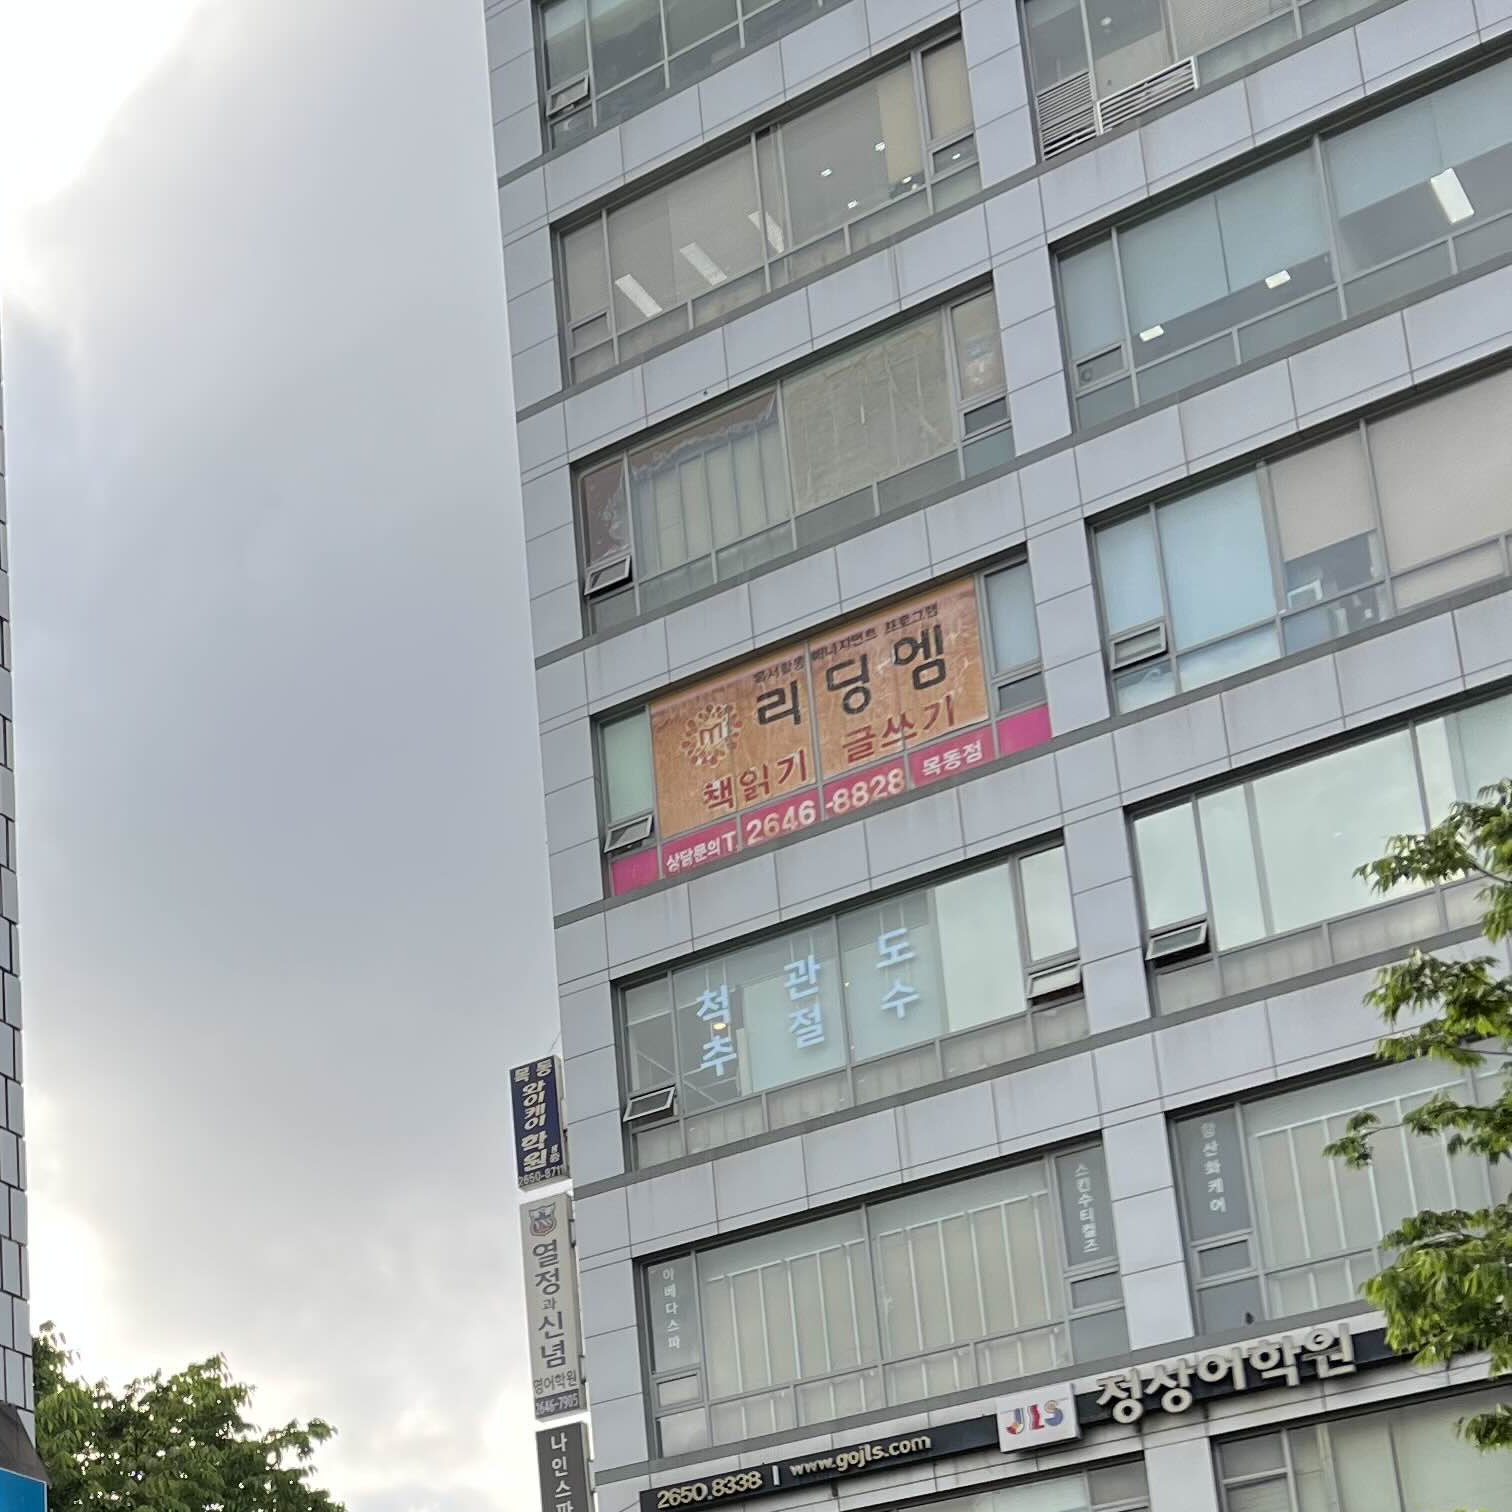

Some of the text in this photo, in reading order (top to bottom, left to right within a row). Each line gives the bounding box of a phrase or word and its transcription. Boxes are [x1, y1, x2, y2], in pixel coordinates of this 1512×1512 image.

[756, 623, 947, 726] 리딩엠
[703, 694, 955, 810] 책읽기 글쓰기
[922, 740, 983, 777] 목동점
[783, 954, 825, 1049] 관절
[876, 927, 920, 1019] 도수
[696, 984, 737, 1077] 척추
[521, 1130, 547, 1173] 학원
[1095, 1322, 1356, 1425] 정상어학원
[656, 1435, 931, 1509] 2650.8338 www.gojls.com
